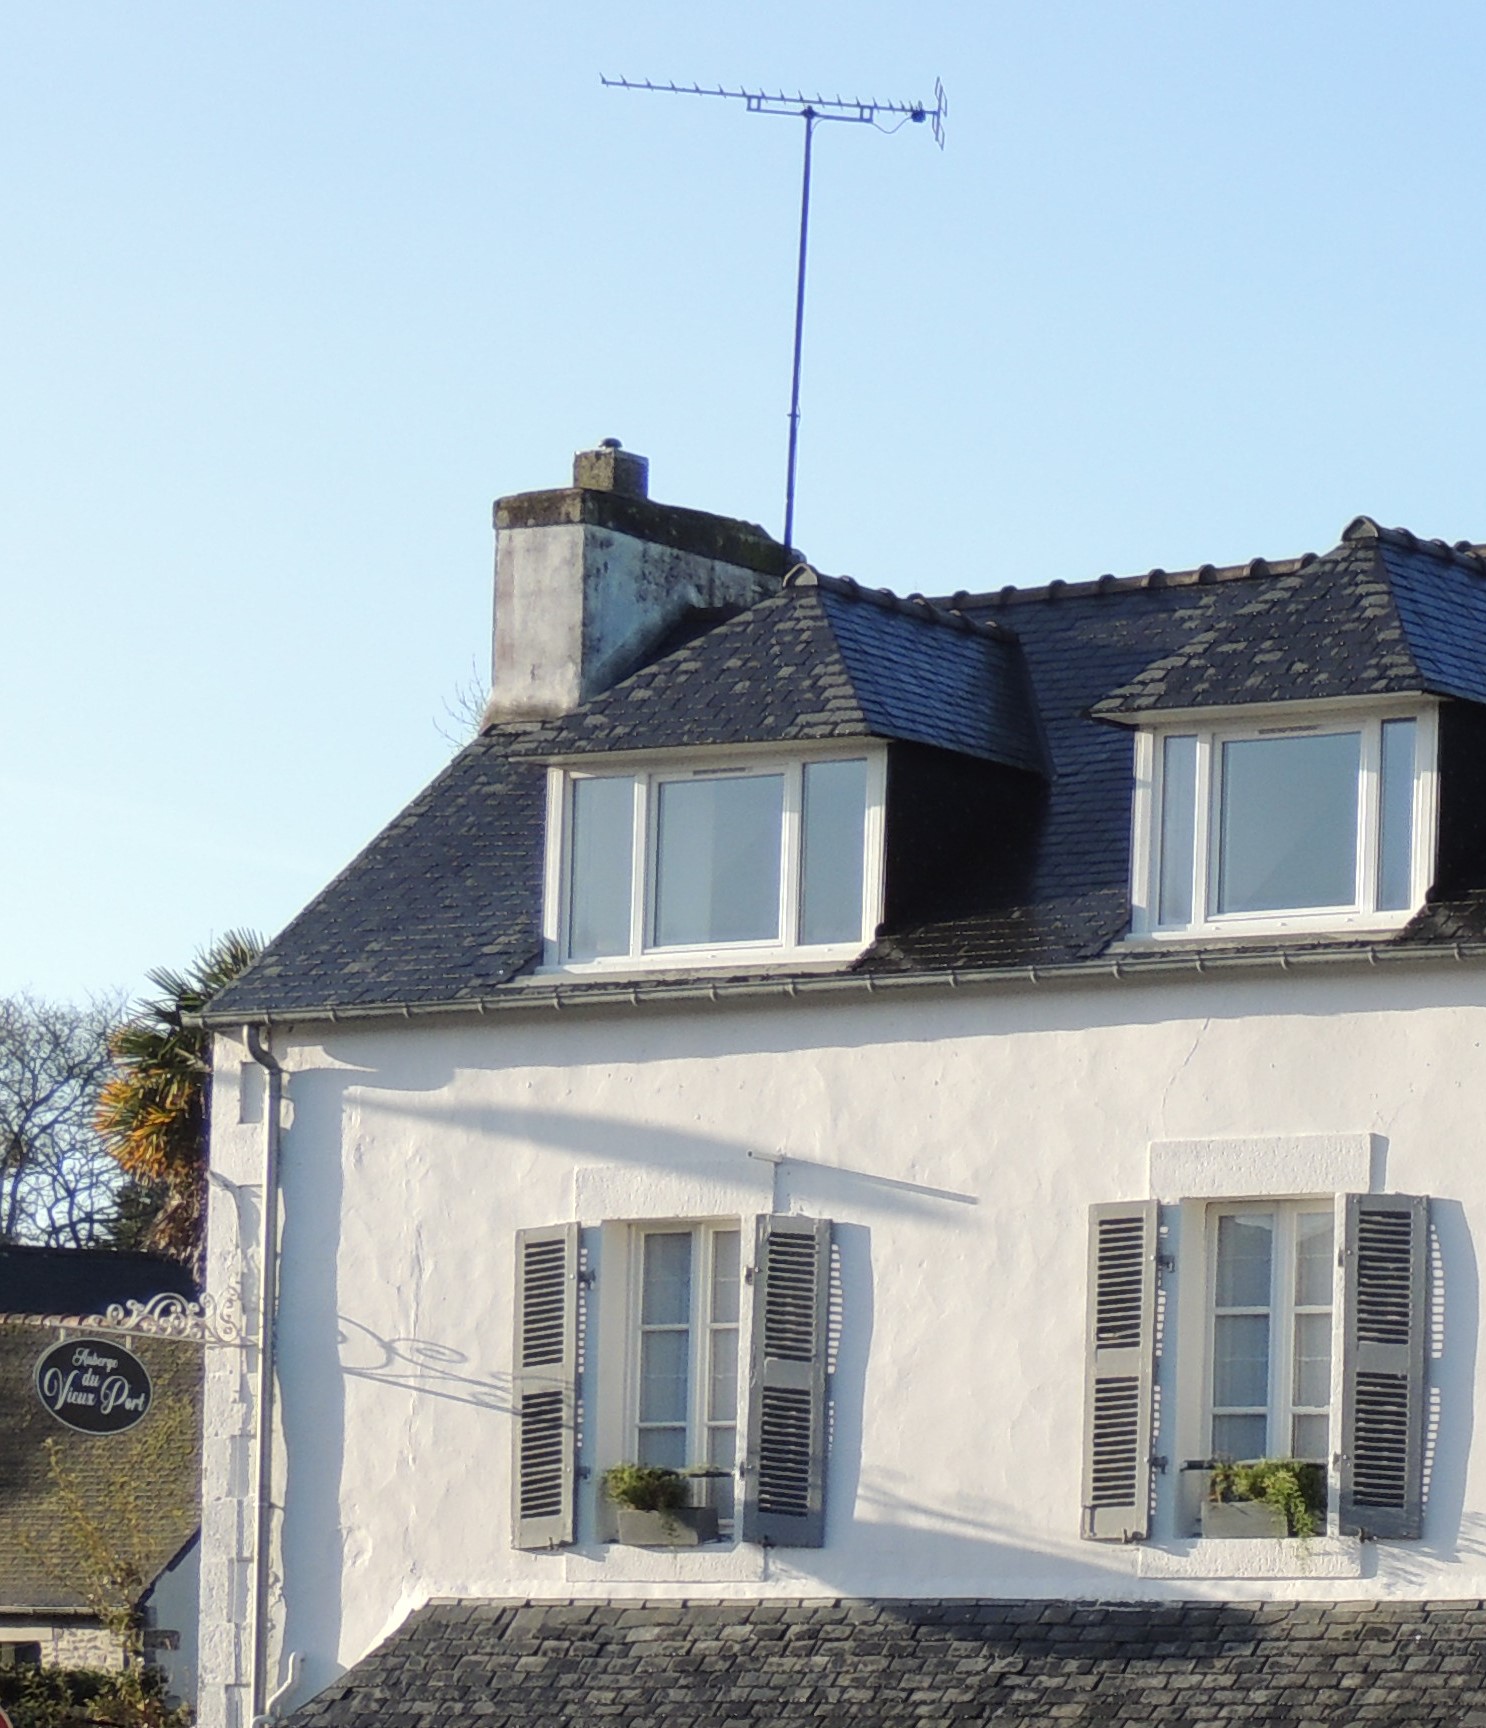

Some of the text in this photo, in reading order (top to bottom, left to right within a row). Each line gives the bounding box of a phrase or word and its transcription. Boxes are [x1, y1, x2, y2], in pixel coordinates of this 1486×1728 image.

[72, 1348, 118, 1373] Auberge
[82, 1368, 99, 1386] du
[44, 1368, 145, 1414] Vieux Port
